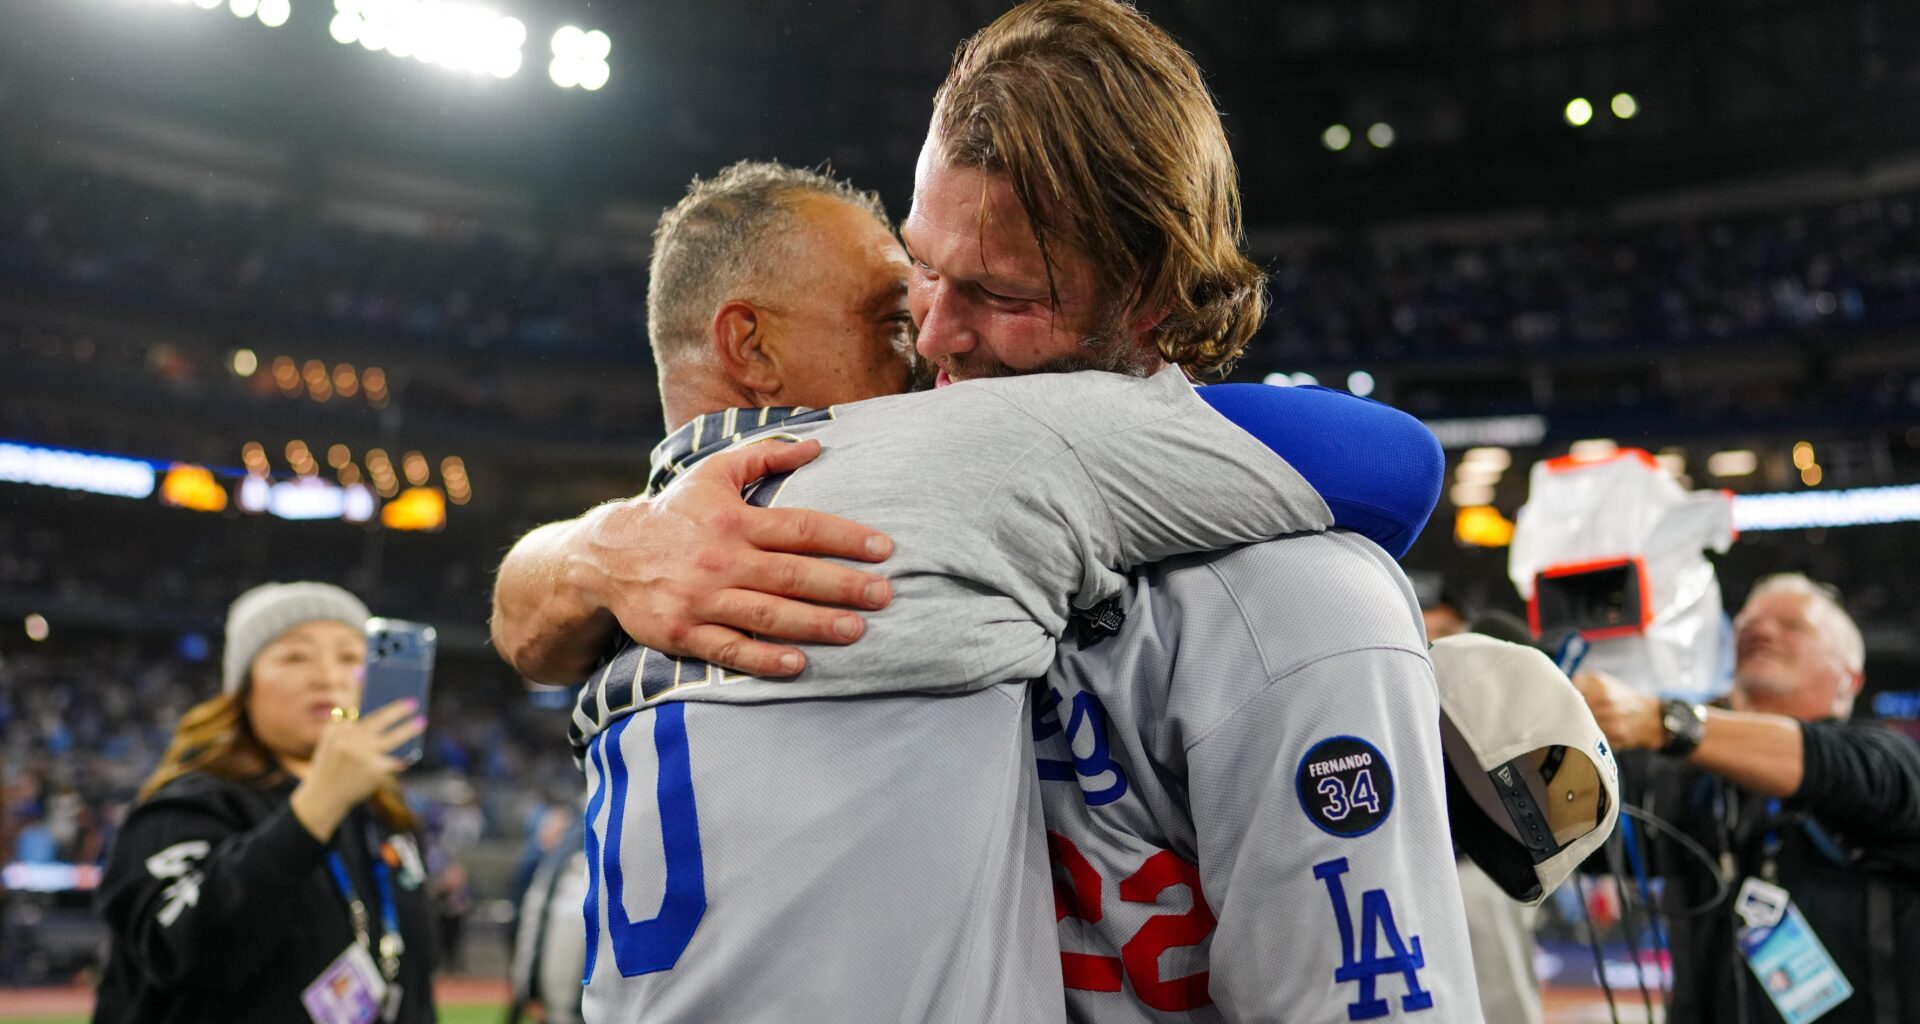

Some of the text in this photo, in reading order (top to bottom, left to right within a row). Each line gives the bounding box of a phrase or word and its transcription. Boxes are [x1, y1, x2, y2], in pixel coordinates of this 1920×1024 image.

[1308, 752, 1372, 778] FERNANDO
[1317, 769, 1379, 820] 34
[1312, 856, 1433, 1021] LA
